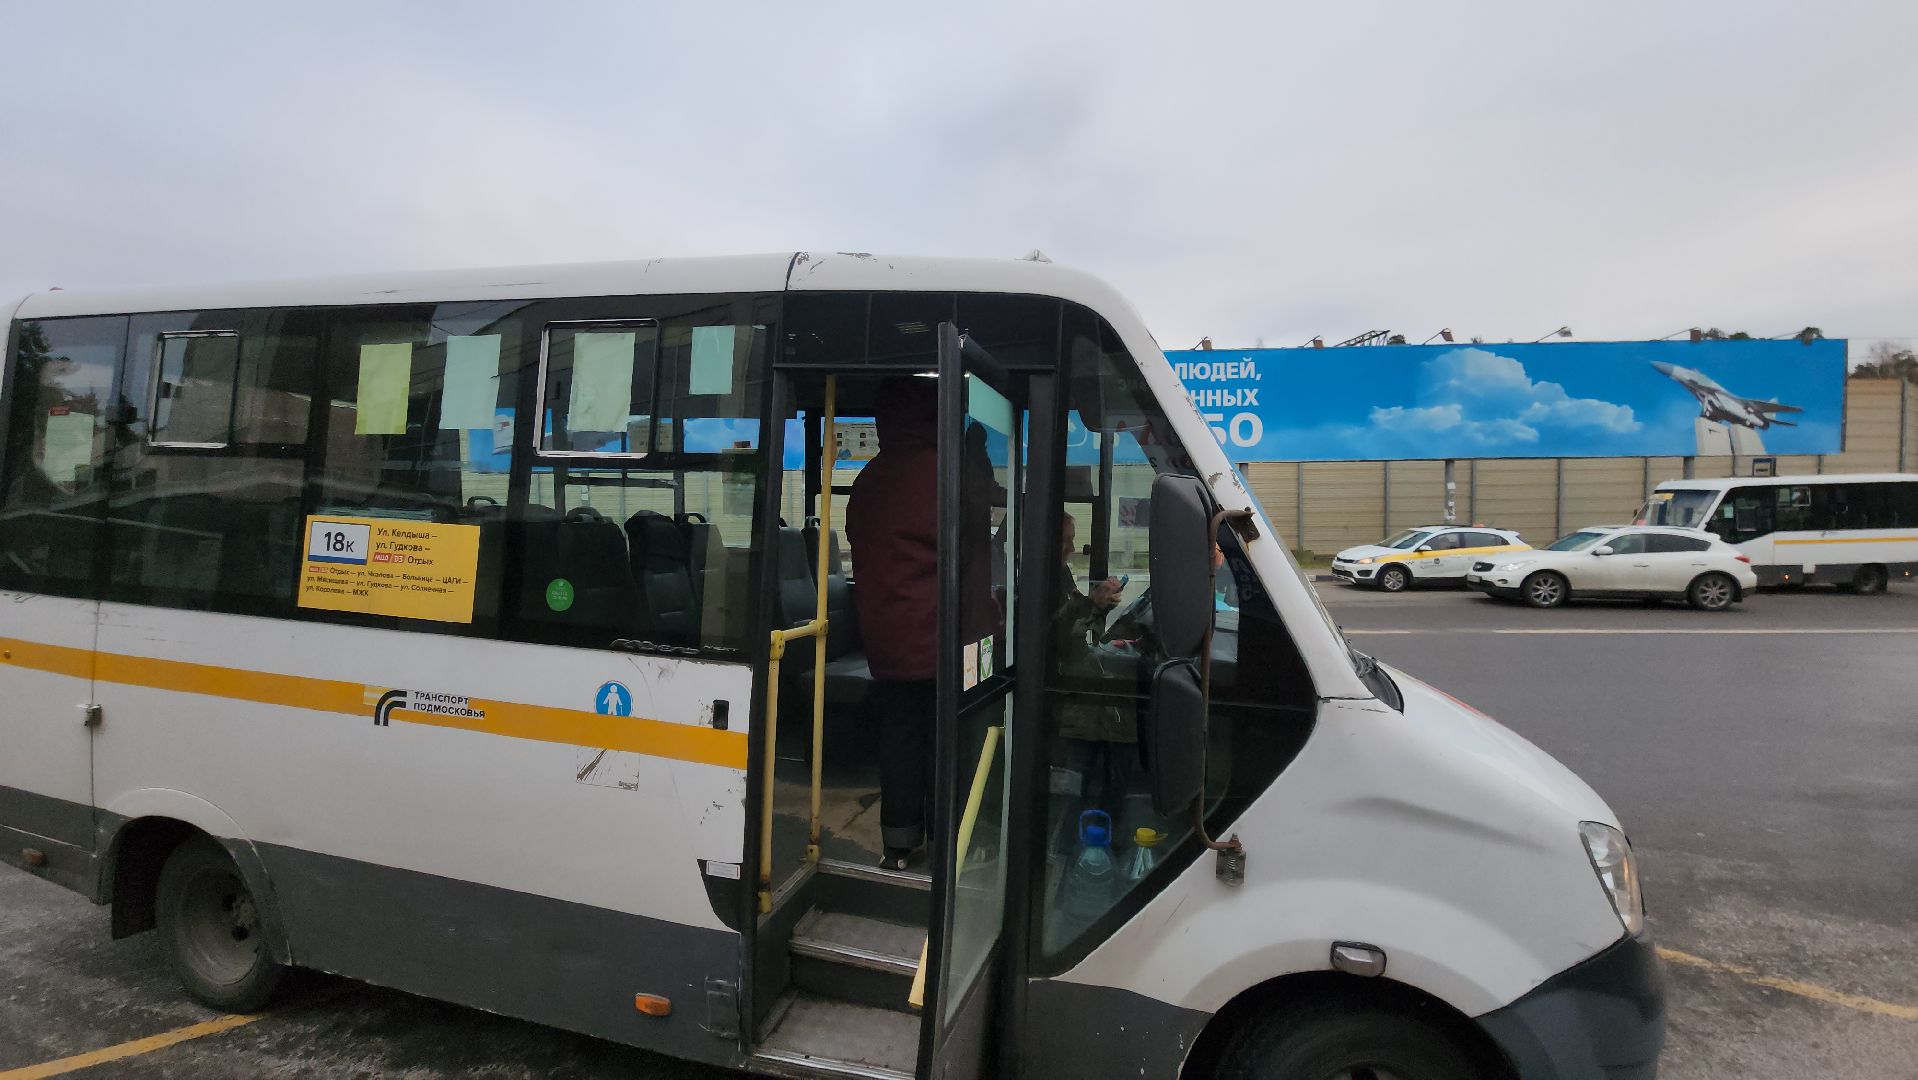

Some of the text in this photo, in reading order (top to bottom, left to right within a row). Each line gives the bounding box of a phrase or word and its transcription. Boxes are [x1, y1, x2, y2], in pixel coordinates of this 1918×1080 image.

[1174, 357, 1262, 382] ЛЮДЕЙ,
[377, 528, 389, 537] Ул.
[391, 528, 430, 540] Келдыша
[375, 542, 388, 551] ул.
[390, 541, 423, 552] Гудкова
[407, 555, 434, 565] Отдых
[329, 566, 350, 576] Отдых
[442, 576, 462, 585] ЦАГИ
[352, 588, 369, 597] МЖК
[366, 580, 393, 589] Гудкова
[411, 584, 447, 594] Солнечная
[414, 691, 469, 705] ТРАНСПОРТ
[413, 702, 485, 719] ПОДМОСКОВЬЯ
